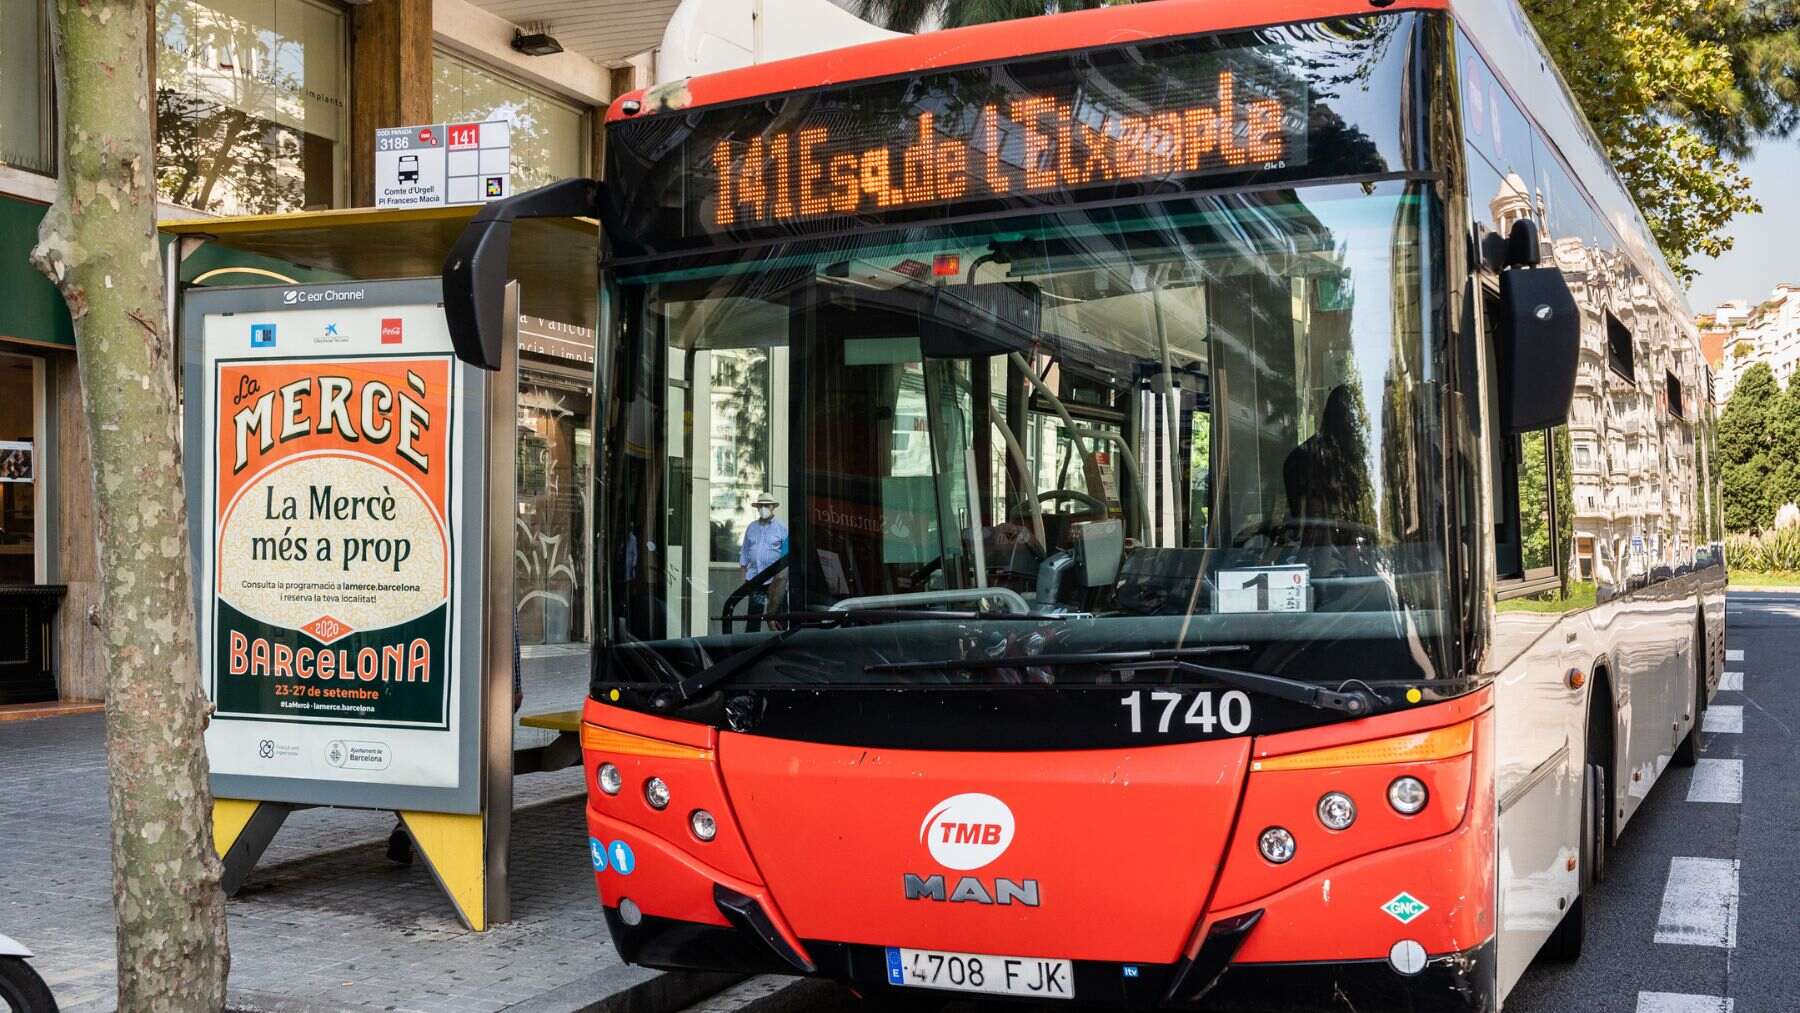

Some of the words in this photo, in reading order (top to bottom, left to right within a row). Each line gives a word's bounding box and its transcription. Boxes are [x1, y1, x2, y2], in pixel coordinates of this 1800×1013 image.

[306, 88, 343, 107] implants
[380, 136, 408, 150] 3186
[452, 130, 476, 145] 141
[712, 133, 793, 224] 141
[384, 187, 406, 196] Comte
[408, 185, 435, 196] d'Urgell
[387, 196, 418, 204] Francesc
[419, 195, 440, 203] Macià
[325, 288, 364, 301] Channel
[233, 374, 260, 405] La
[233, 369, 429, 475] MERCÈ
[265, 485, 297, 520] La
[309, 485, 396, 521] Mercè
[252, 526, 308, 561] més
[316, 537, 331, 561] a
[343, 537, 411, 572] prop
[241, 580, 276, 589] Consulta
[277, 581, 284, 589] la
[285, 581, 335, 592] programació
[342, 582, 420, 592] lamerce.barcelona
[1242, 573, 1269, 611] 1
[314, 594, 321, 602] la
[322, 594, 340, 602] teva
[341, 594, 377, 604] localitat!
[315, 620, 339, 638] 2020
[275, 684, 306, 696] 23-27
[307, 686, 321, 697] de
[323, 687, 380, 700] setembre
[313, 702, 376, 713] lamerce.barcelona
[1121, 690, 1252, 734] 1740
[350, 753, 383, 763] Barcelona
[940, 822, 1002, 845] TMB
[903, 873, 1040, 907] MAN
[1390, 902, 1419, 914] GNC
[893, 968, 900, 978] E
[911, 953, 985, 987] 4708
[1004, 959, 1064, 993] FJK
